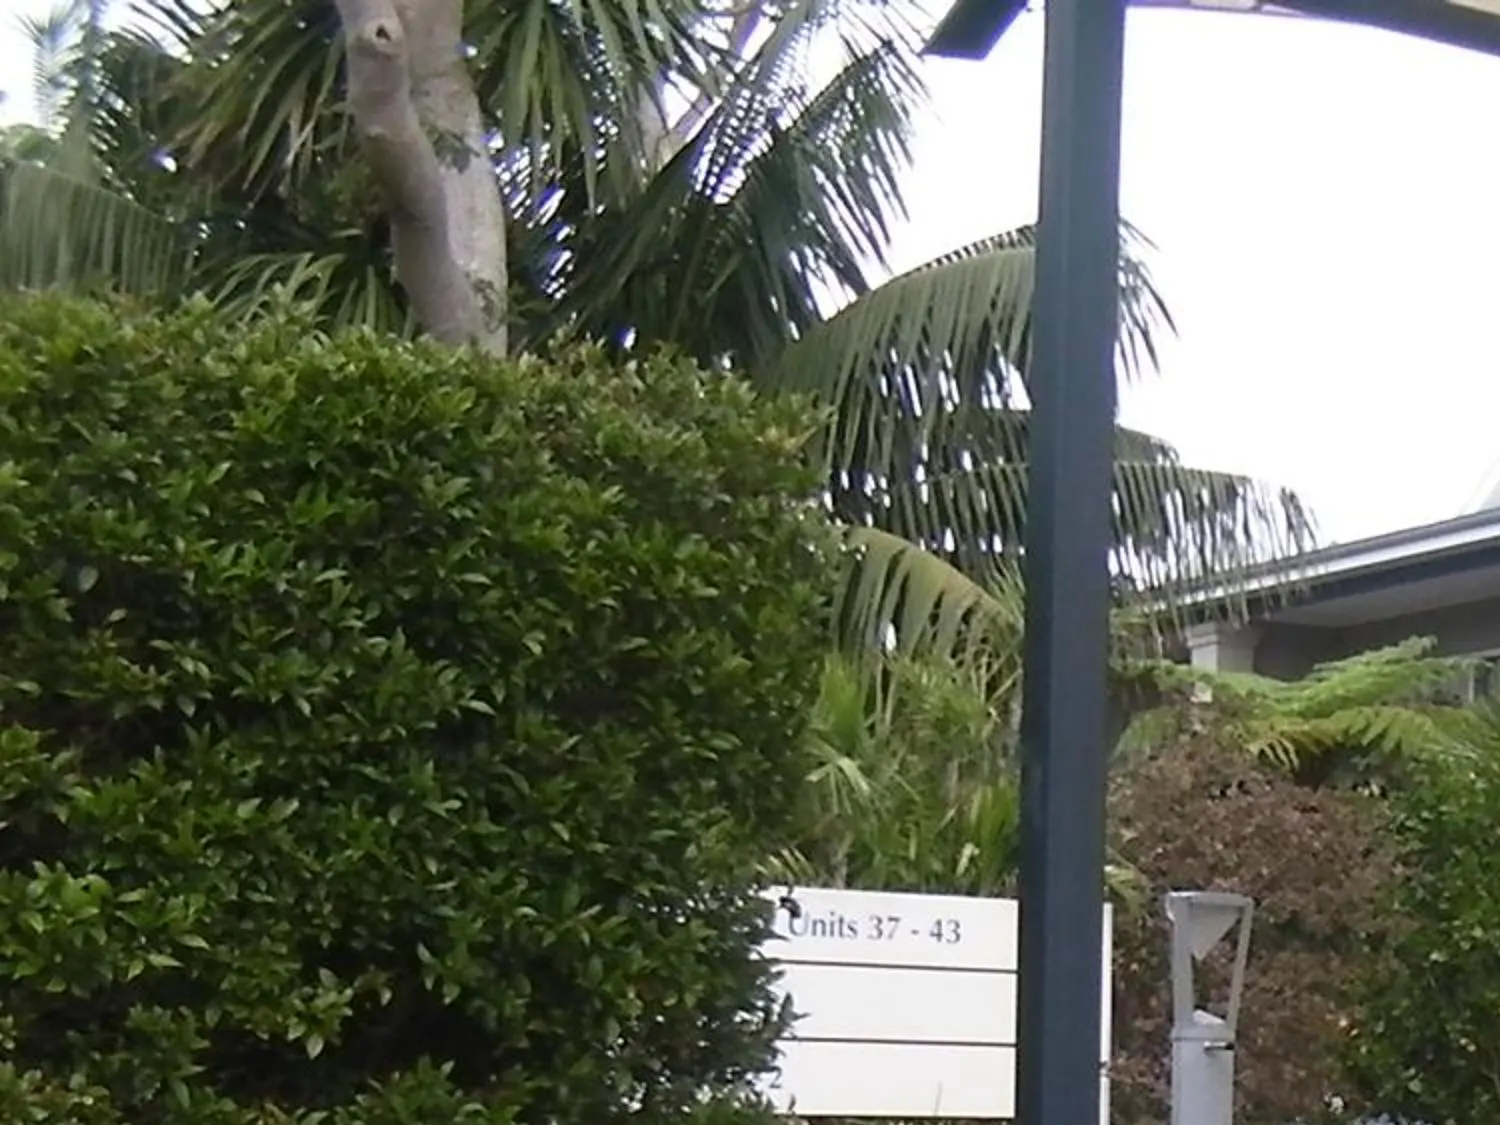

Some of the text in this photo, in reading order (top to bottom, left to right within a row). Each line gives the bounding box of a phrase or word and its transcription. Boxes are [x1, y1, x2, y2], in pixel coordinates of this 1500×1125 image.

[787, 909, 858, 940] Units
[867, 914, 901, 941] 37
[928, 918, 962, 945] 43
